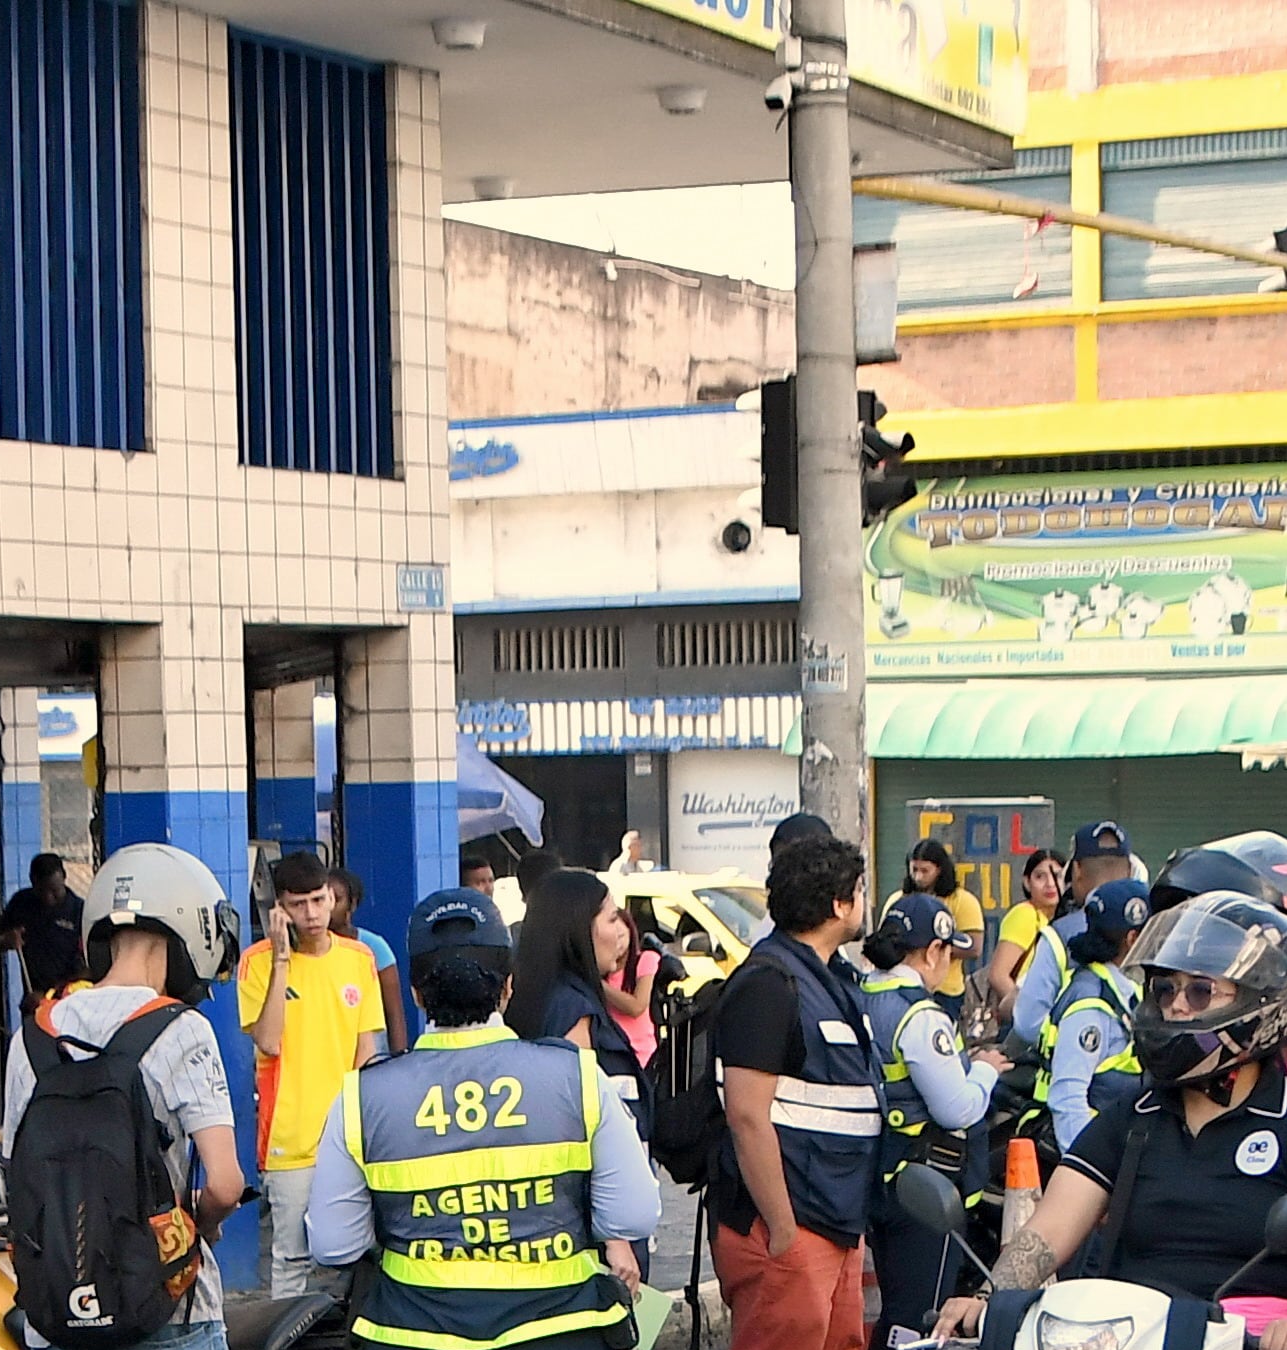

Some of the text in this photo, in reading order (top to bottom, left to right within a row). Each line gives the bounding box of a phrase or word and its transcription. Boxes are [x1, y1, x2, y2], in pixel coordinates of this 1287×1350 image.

[1127, 484, 1142, 504] y
[937, 650, 993, 664] Nacionales
[681, 791, 795, 828] Washington
[189, 1047, 212, 1067] NEW
[414, 1075, 528, 1136] 482
[411, 1177, 555, 1218] AGENTE
[461, 1216, 512, 1245] DE
[69, 1283, 102, 1320] G
[66, 1315, 115, 1328] GATORADE
